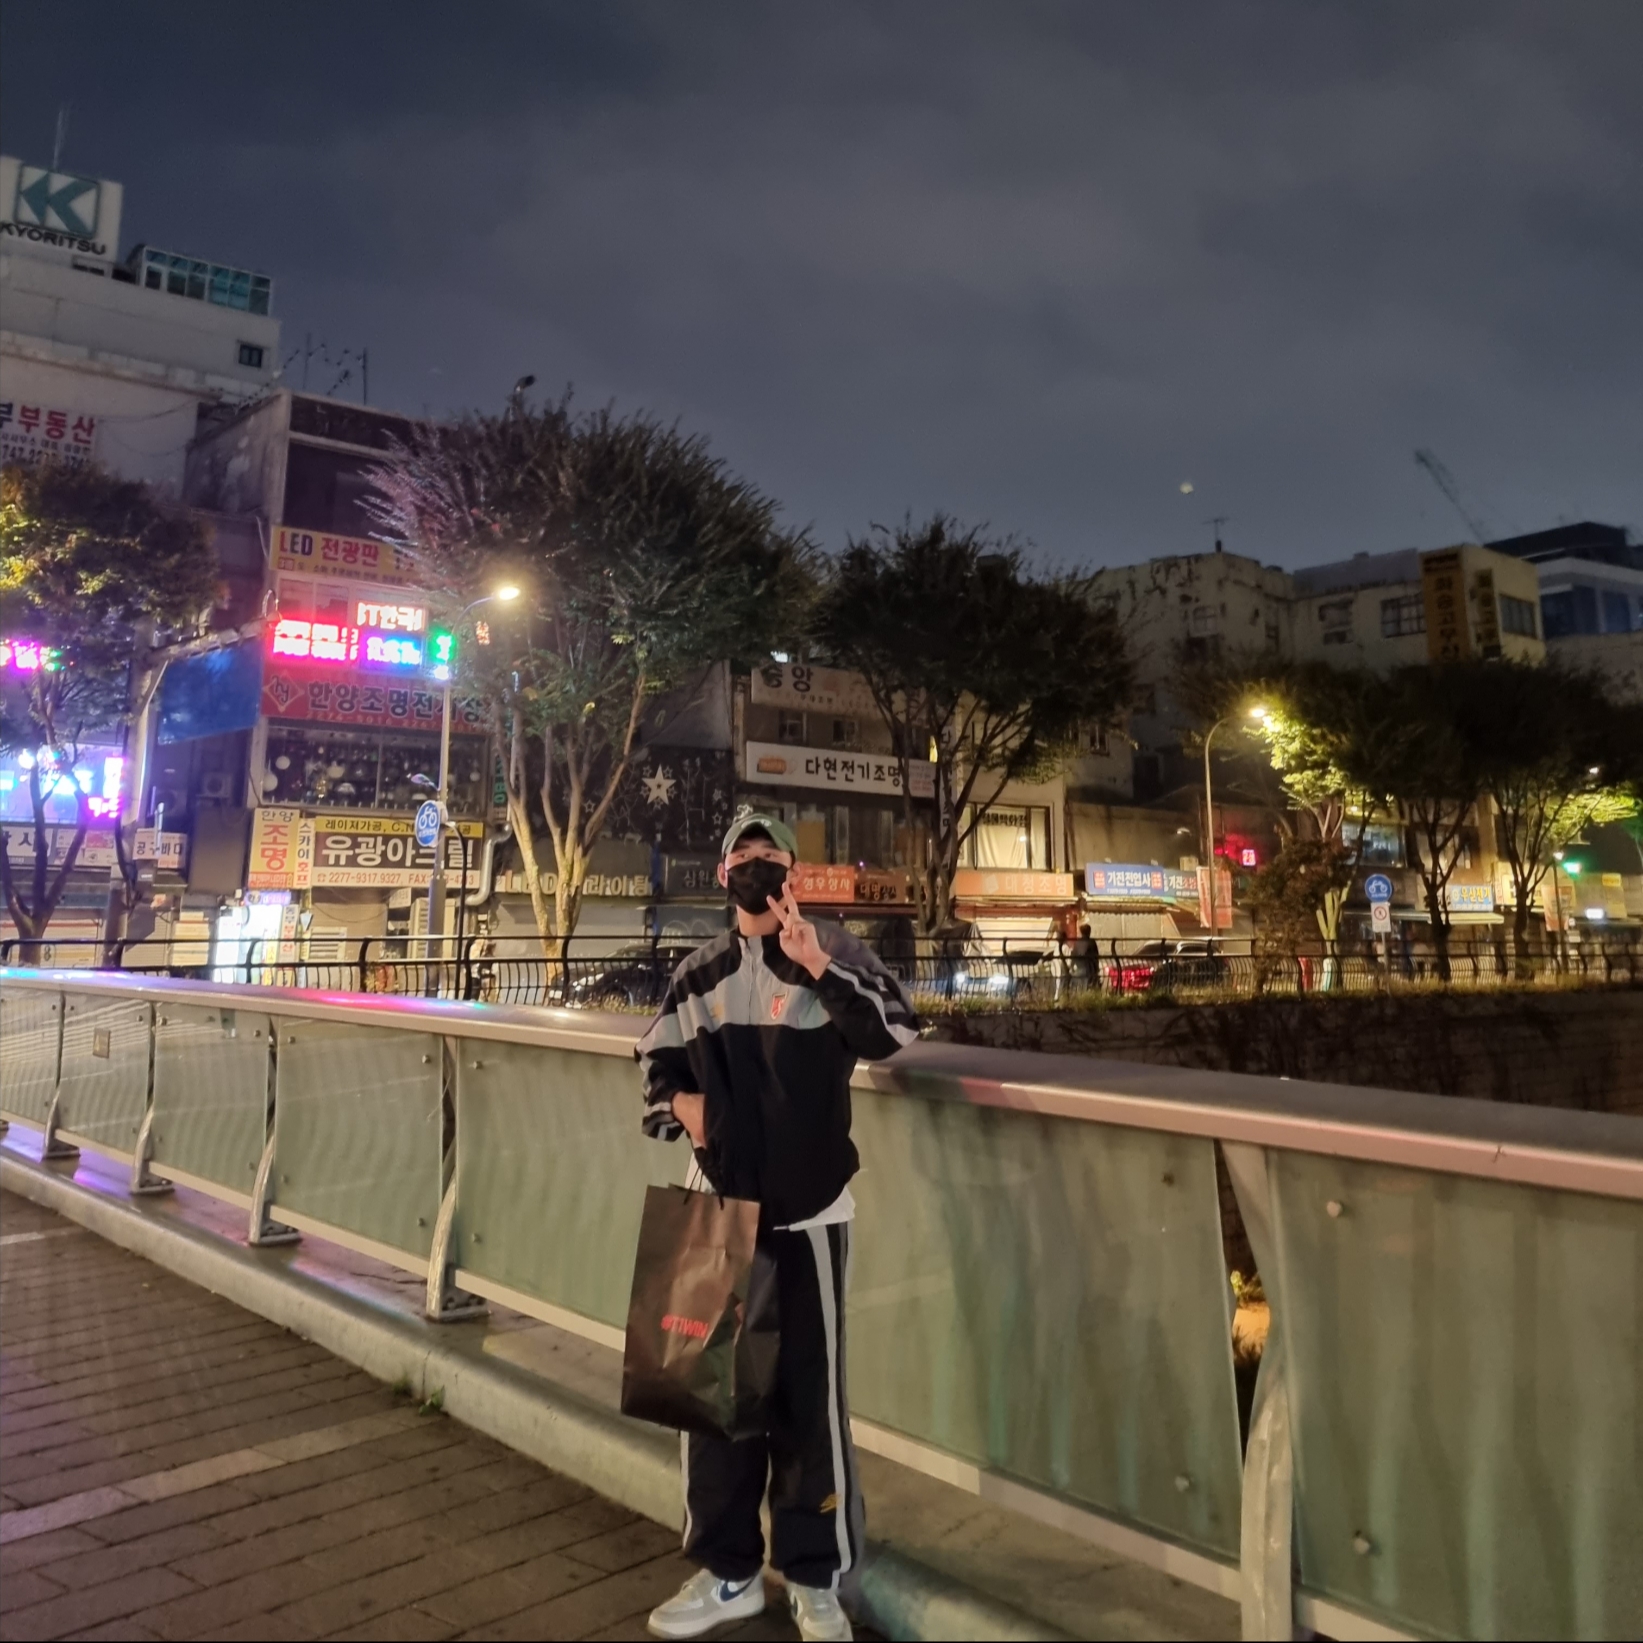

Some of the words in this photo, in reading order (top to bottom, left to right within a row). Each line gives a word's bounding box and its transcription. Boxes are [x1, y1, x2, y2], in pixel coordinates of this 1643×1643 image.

[0, 222, 105, 255] KYORITSU
[279, 530, 313, 557] LED
[320, 536, 379, 567] 전광판
[803, 756, 899, 787] 다현전기조명
[261, 811, 293, 823] 한양
[260, 824, 289, 871] 조명
